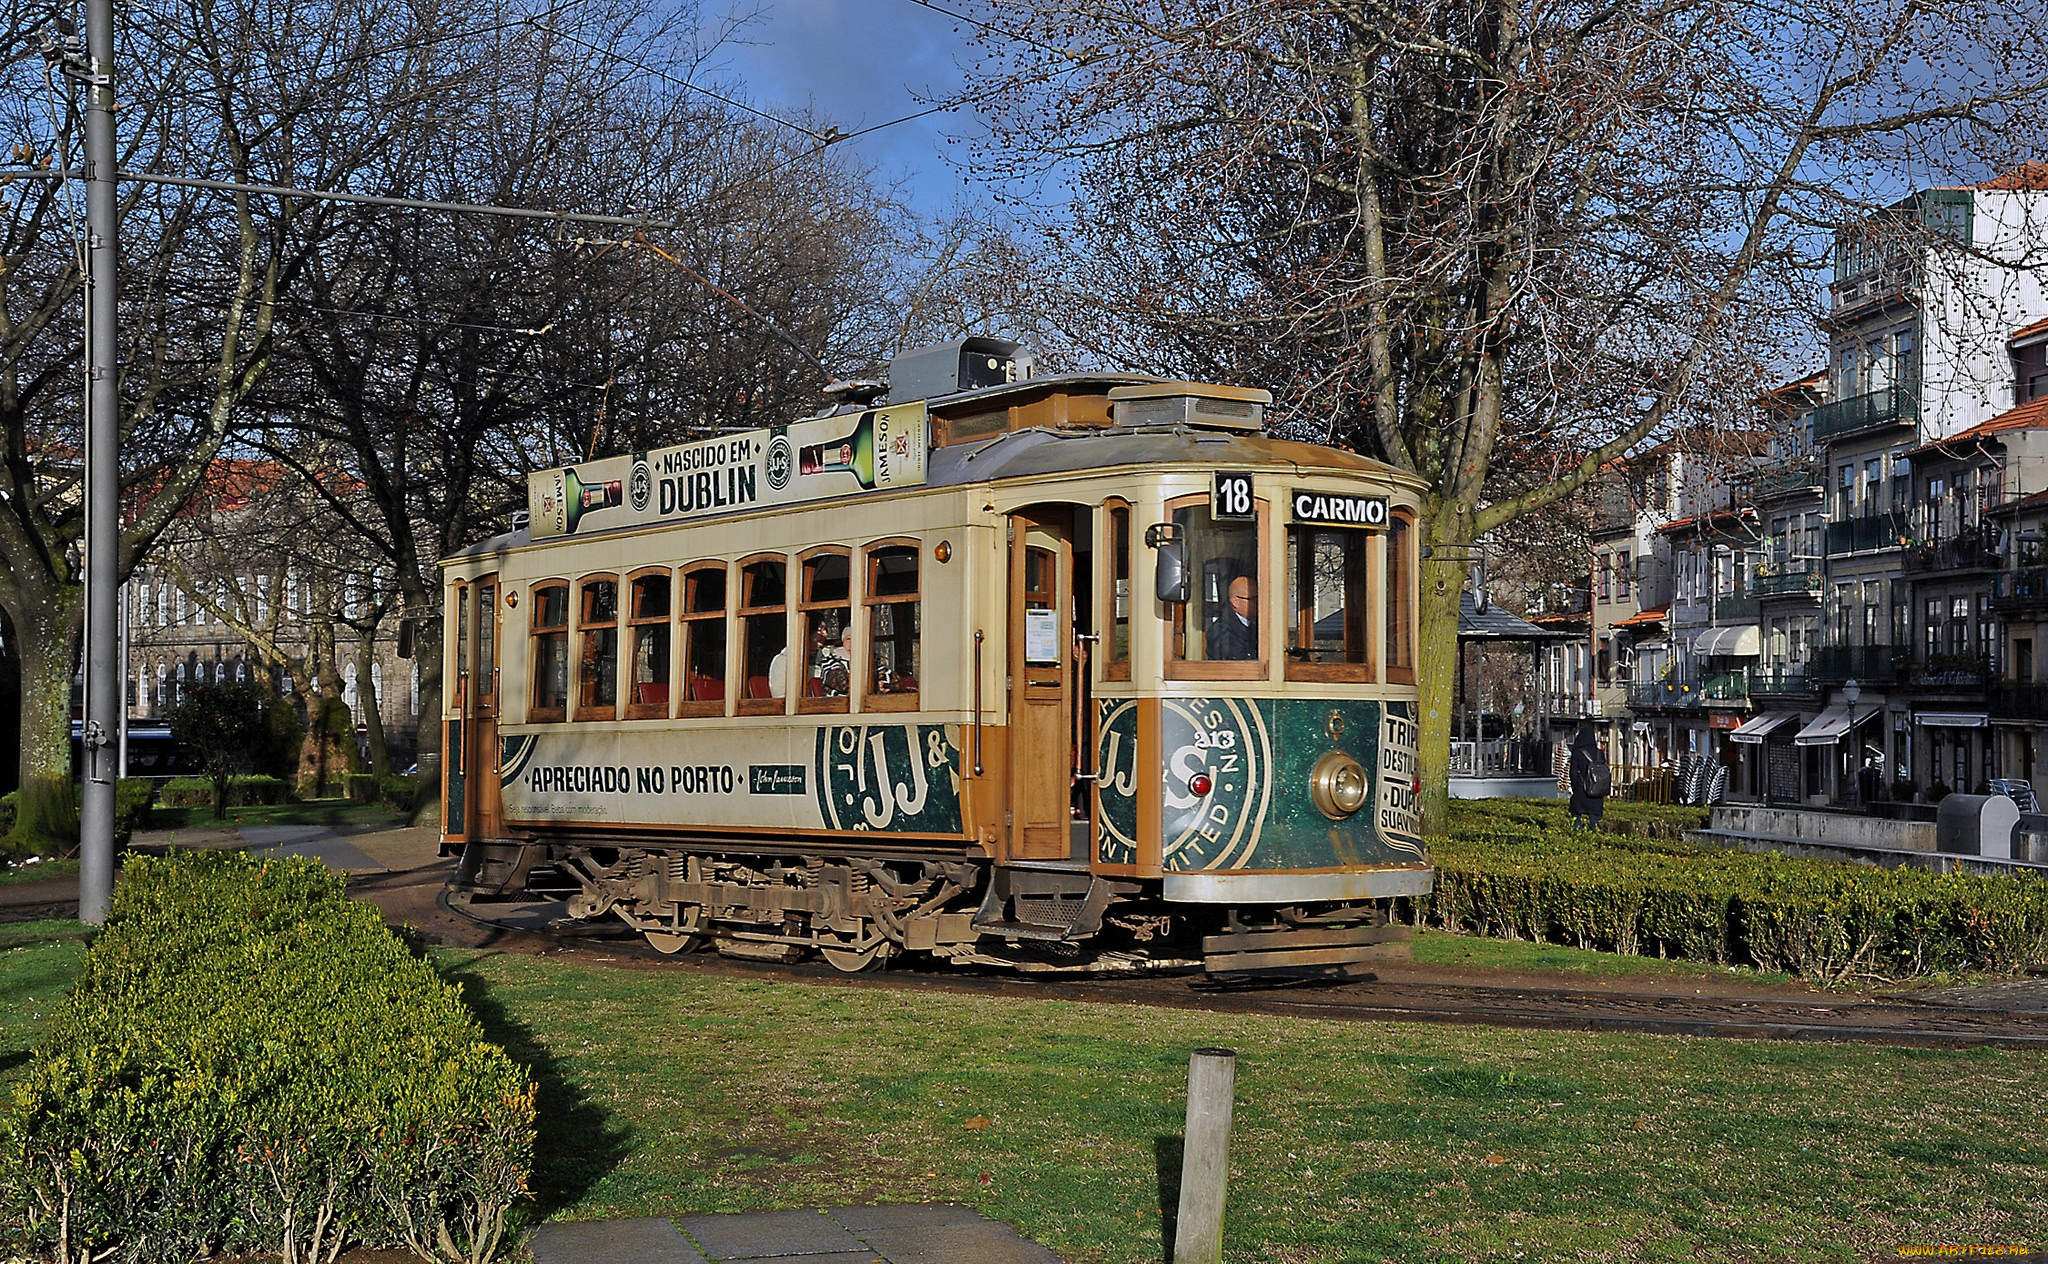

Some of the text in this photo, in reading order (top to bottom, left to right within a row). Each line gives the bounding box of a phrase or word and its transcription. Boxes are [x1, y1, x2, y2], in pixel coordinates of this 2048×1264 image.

[663, 444, 727, 475] NASCIDO
[730, 439, 751, 463] EM
[878, 414, 891, 483] JAMESON
[553, 474, 564, 531] JAMESON
[660, 464, 756, 515] DUBLIN
[1220, 478, 1250, 513] 18
[1296, 495, 1384, 523] CARMO
[1194, 730, 1236, 749] 213
[531, 765, 734, 794] APRECIADO NO PORTO
